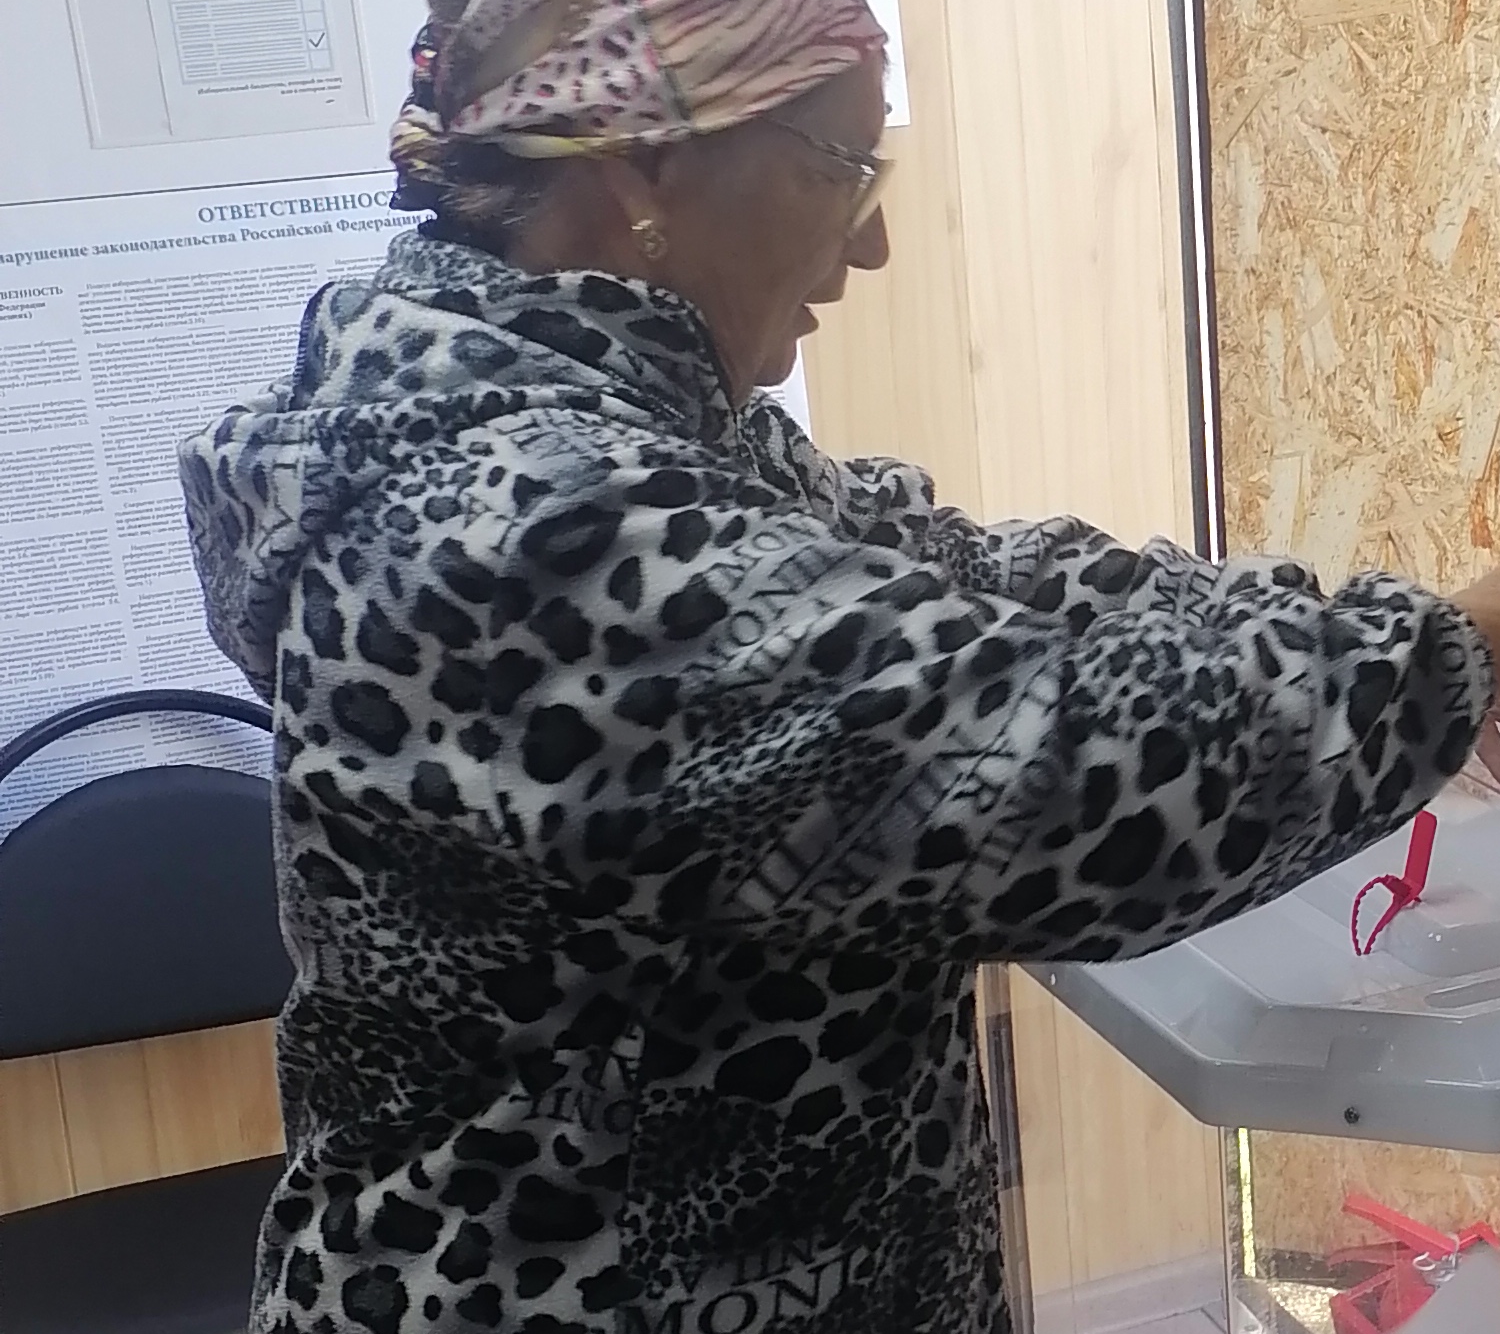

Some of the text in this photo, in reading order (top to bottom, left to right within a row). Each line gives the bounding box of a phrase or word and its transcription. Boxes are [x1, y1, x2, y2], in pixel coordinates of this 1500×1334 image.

[92, 231, 236, 256] законодательства
[240, 219, 332, 247] Российской
[335, 213, 421, 238] Федерации
[0, 286, 63, 300] ВЕННОСТЬ
